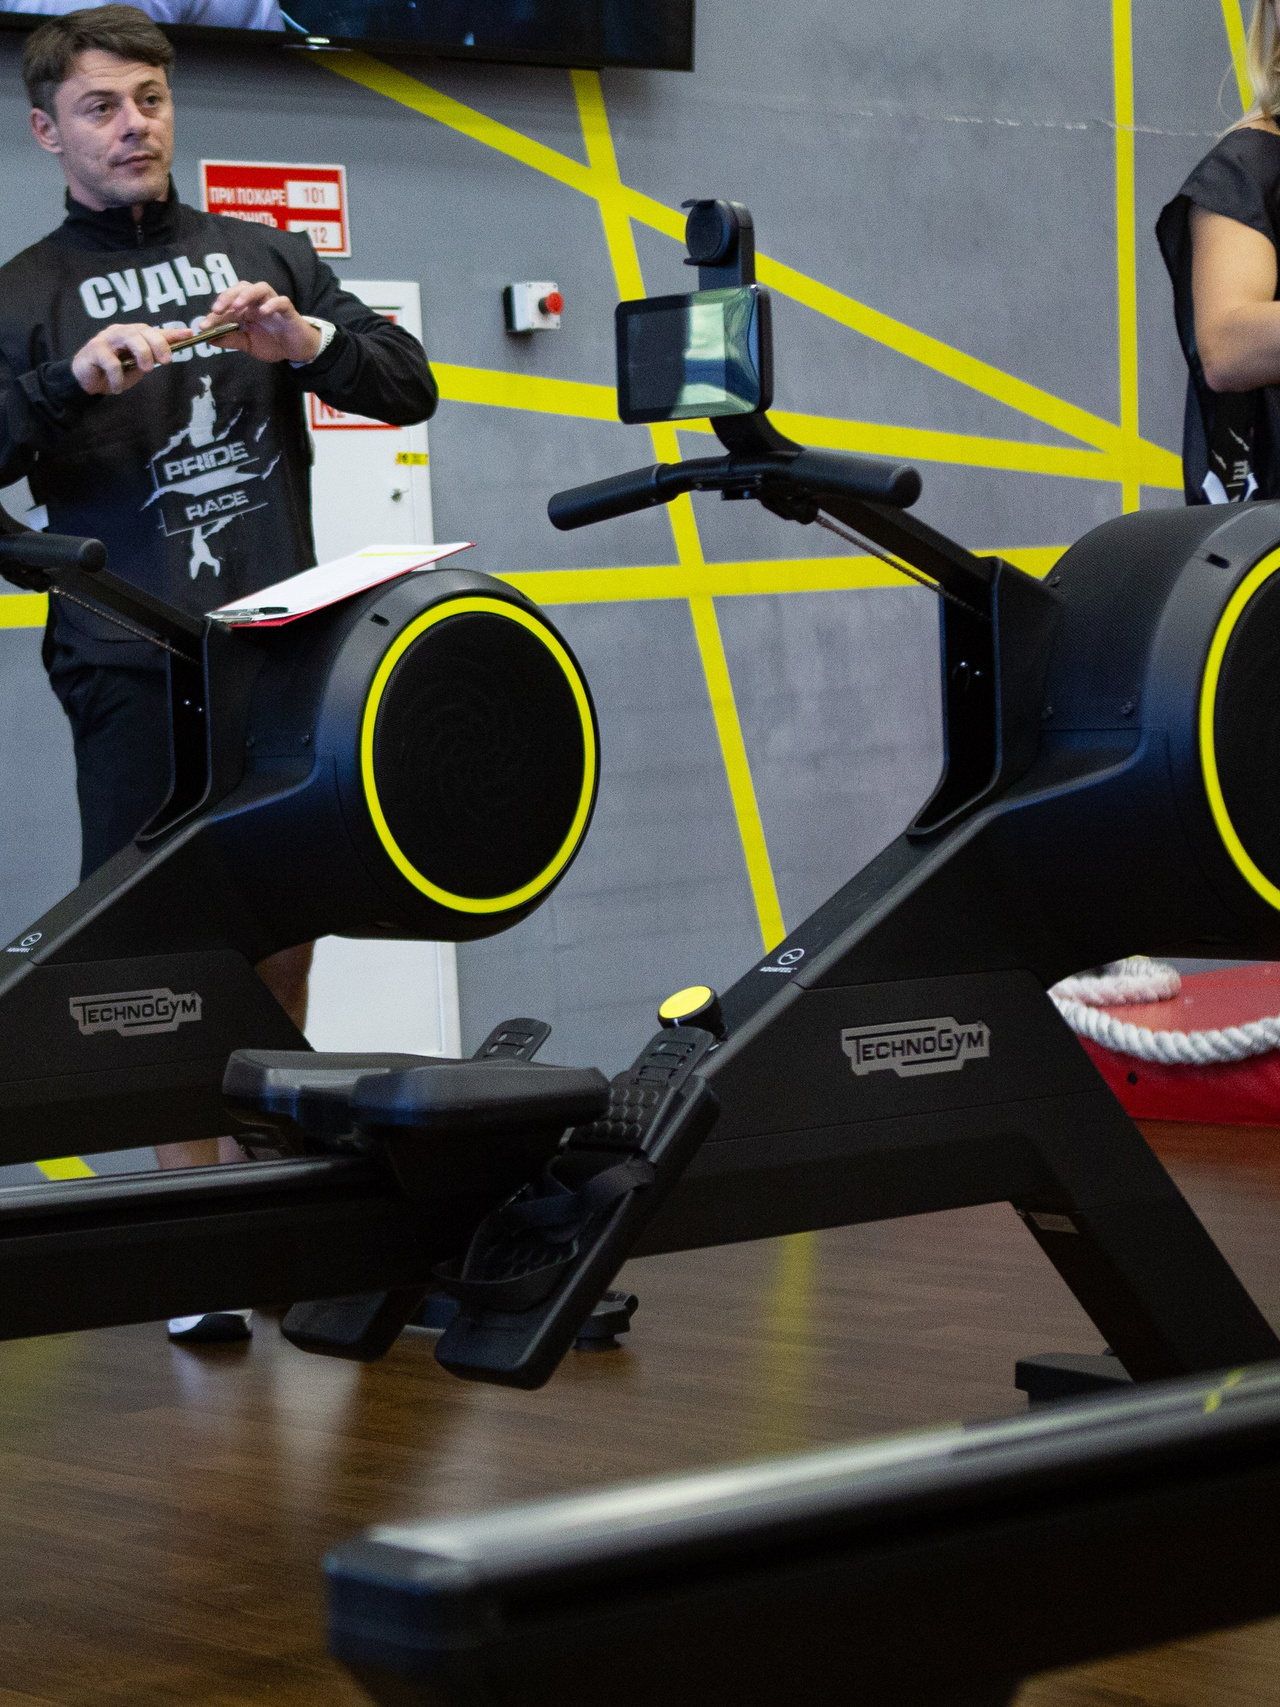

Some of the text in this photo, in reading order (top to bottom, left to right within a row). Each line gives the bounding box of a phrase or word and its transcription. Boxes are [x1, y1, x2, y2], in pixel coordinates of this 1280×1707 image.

[209, 187, 286, 206] ПРИ ПОЖАРЕ
[303, 187, 326, 204] 101
[306, 227, 328, 244] 12
[164, 441, 249, 480] PRIDE
[185, 490, 249, 520] RACE
